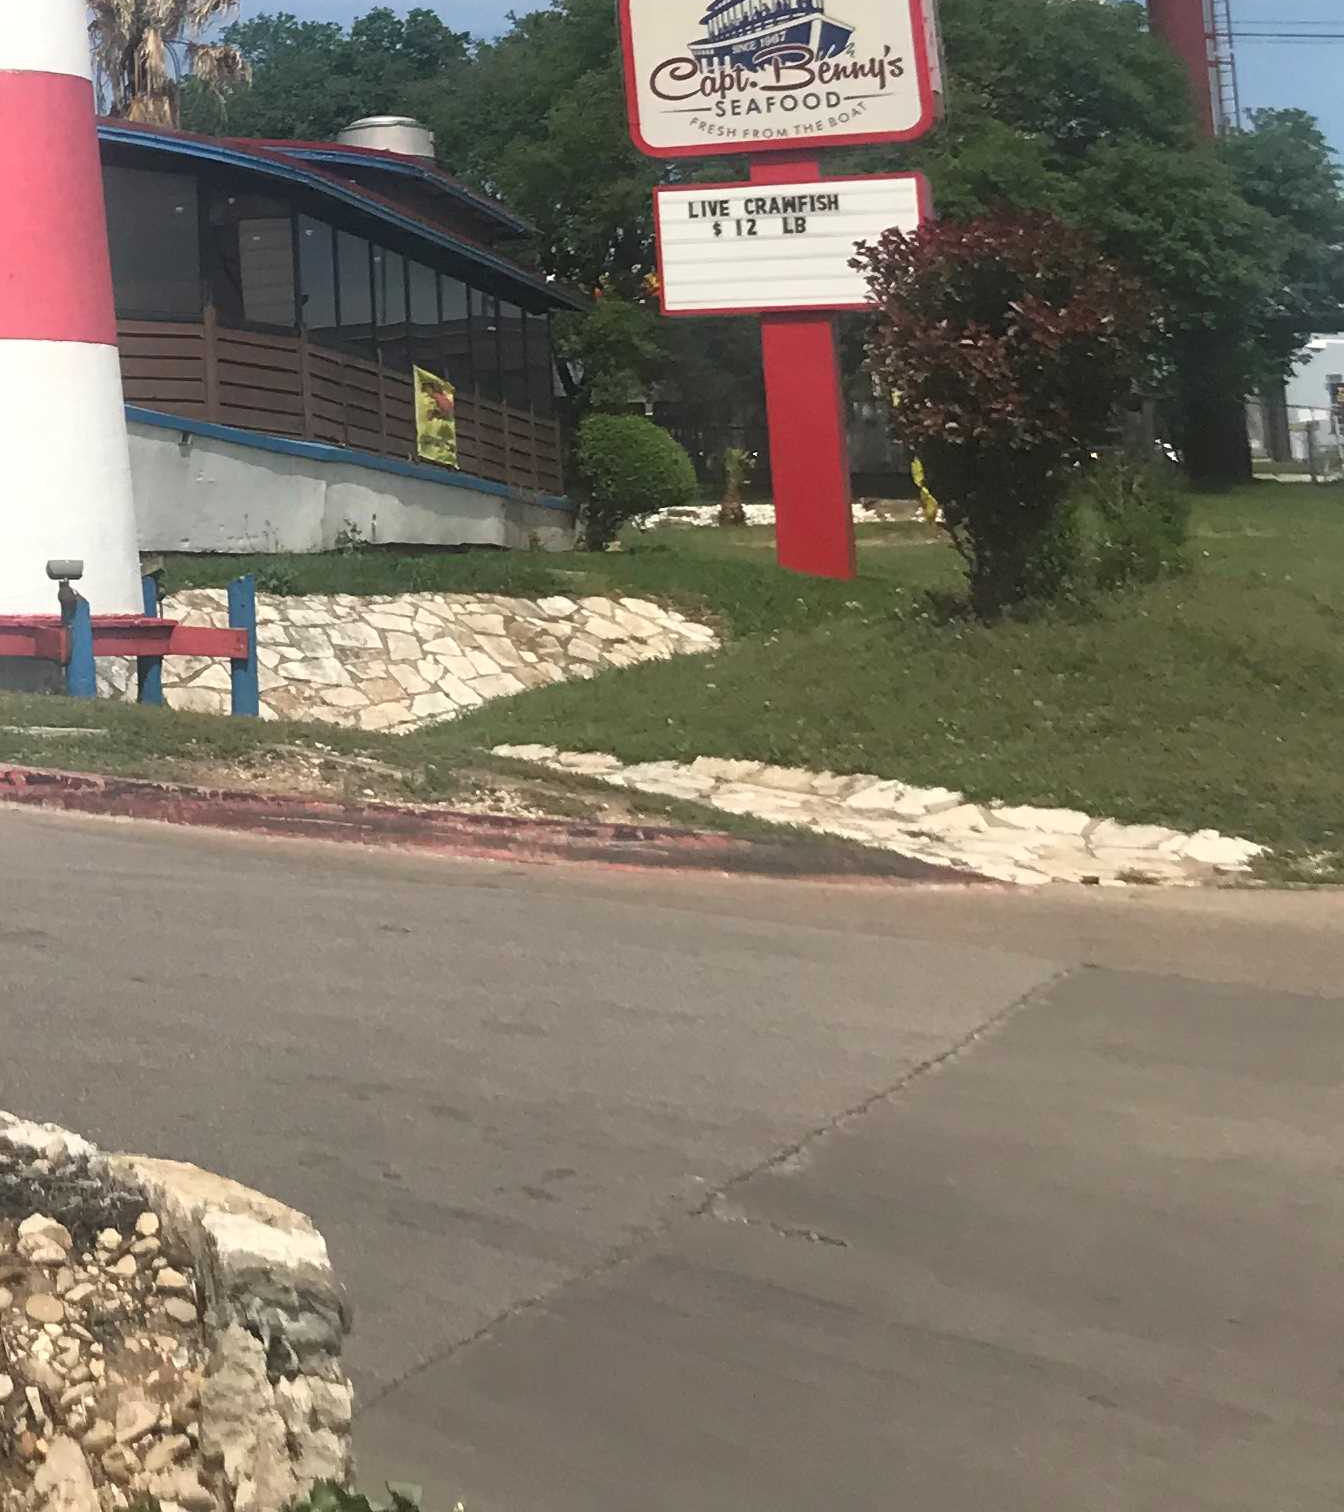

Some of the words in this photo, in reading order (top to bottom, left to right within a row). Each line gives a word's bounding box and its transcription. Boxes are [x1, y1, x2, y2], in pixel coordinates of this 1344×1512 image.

[732, 41, 757, 55] SINCE
[650, 57, 758, 100] Capt.
[753, 44, 904, 91] Benny's
[715, 91, 841, 117] SEAFOOD
[689, 116, 737, 138] FRESH
[743, 128, 788, 140] FROM
[794, 120, 823, 136] THE
[828, 101, 867, 127] BOAT
[688, 200, 730, 219] LIVE
[744, 193, 839, 215] CRAWFISH
[782, 216, 806, 234] LB
